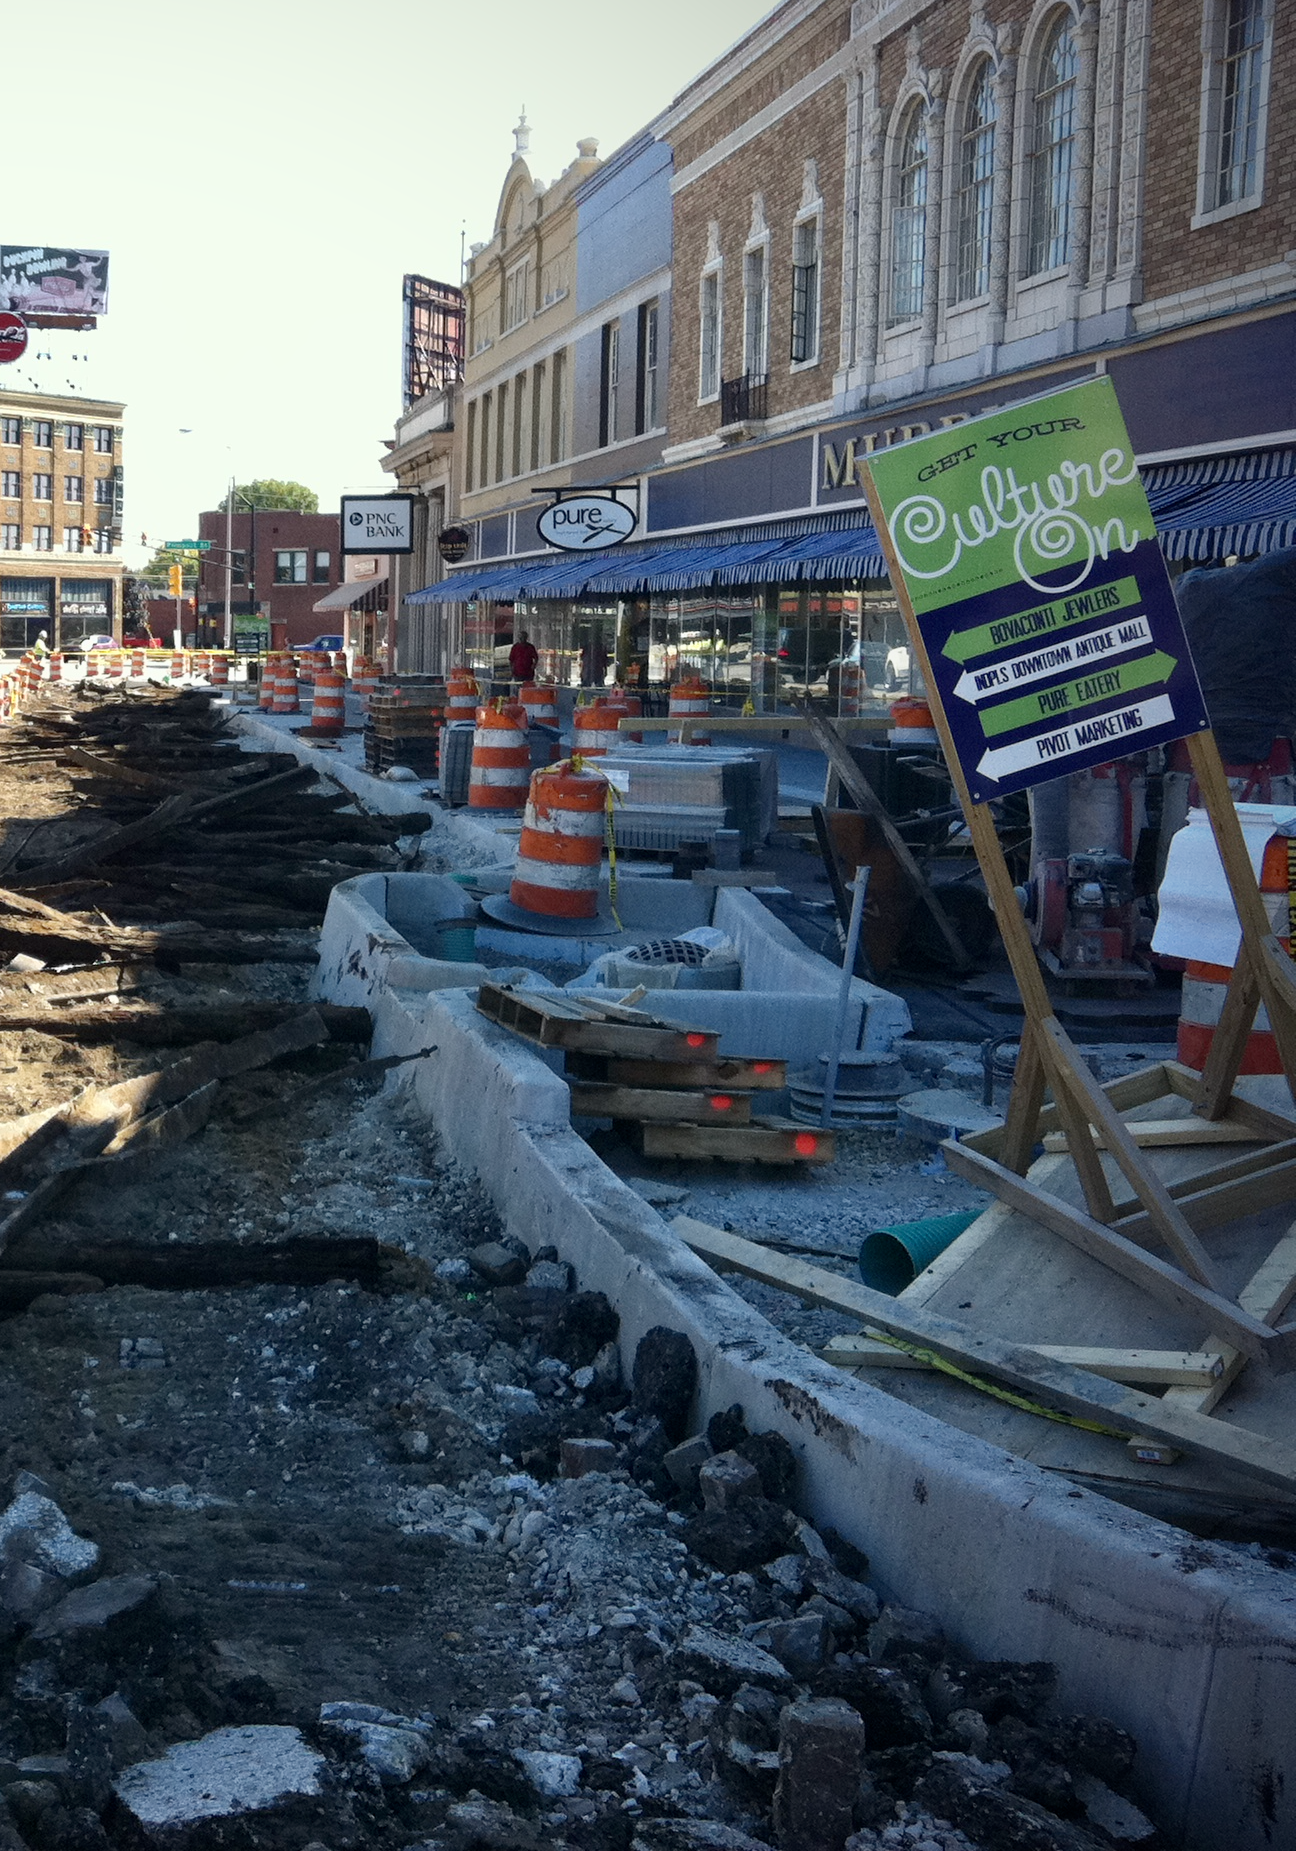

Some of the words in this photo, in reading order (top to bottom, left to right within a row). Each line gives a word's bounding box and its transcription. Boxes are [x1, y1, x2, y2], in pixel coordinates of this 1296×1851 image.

[917, 444, 978, 483] GET
[986, 417, 1086, 449] YOUR
[366, 512, 397, 525] PNC
[366, 526, 405, 538] BANK
[552, 507, 603, 530] pure
[889, 448, 1139, 579] Culture
[1014, 509, 1139, 594] On
[990, 607, 1057, 645] BOVACONTI
[1062, 586, 1121, 622] JEWLERS
[974, 667, 1010, 691] INDPLS
[1012, 645, 1073, 679] DOWNTOWN
[1076, 632, 1116, 659] ANTIQUE
[1118, 622, 1147, 643] MALL
[1037, 689, 1073, 714] PURE
[1075, 670, 1123, 702] EATERY
[1036, 731, 1072, 759] PIVOT
[1074, 709, 1143, 747] MARKETING
